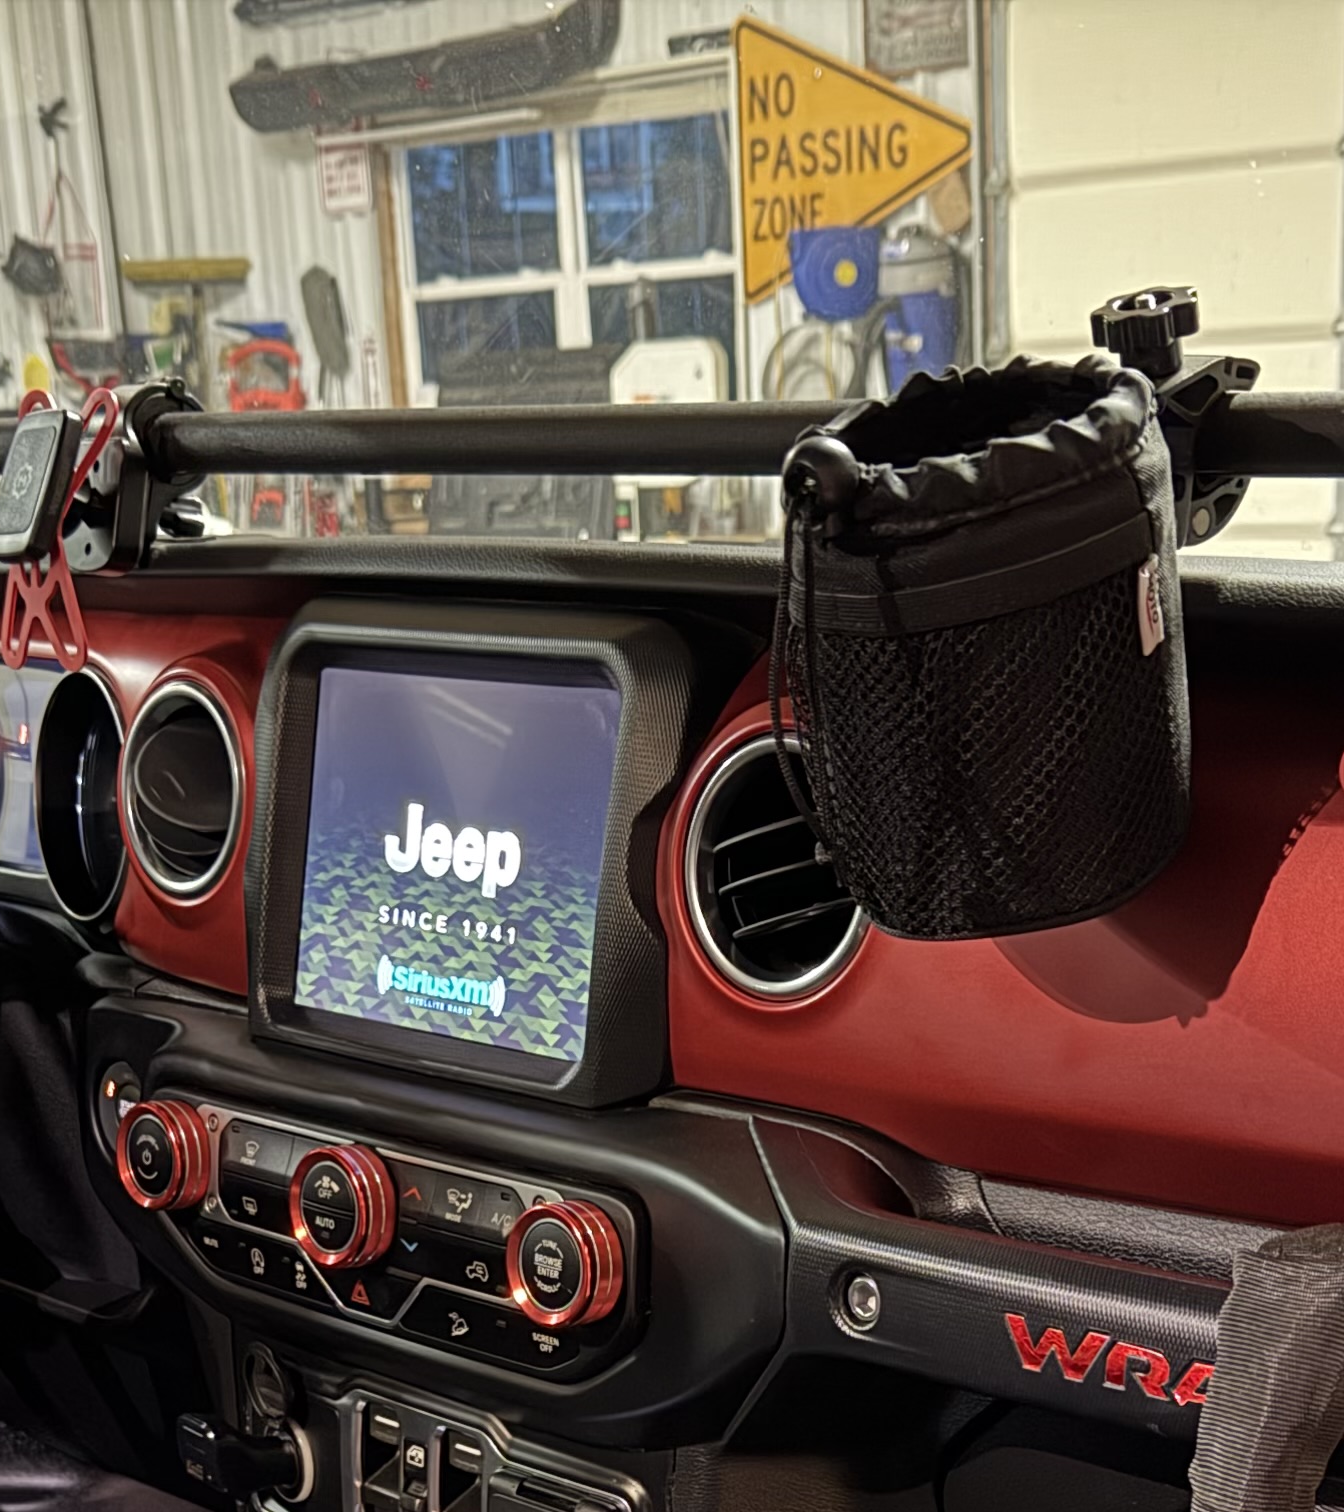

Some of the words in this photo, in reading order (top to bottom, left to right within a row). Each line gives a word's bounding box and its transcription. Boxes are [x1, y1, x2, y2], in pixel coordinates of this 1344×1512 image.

[748, 72, 795, 123] NO
[749, 122, 909, 184] PASSING
[384, 802, 522, 899] Jeep
[378, 905, 449, 935] SINCE
[461, 919, 518, 945] 1941
[447, 1003, 473, 1017] RADIO
[318, 1188, 333, 1200] OFF
[315, 1215, 336, 1230] AUTO
[491, 1212, 513, 1227] A/C
[534, 1252, 563, 1269] BROWSE
[537, 1265, 560, 1280] ENTER
[532, 1332, 560, 1347] SCREEN
[539, 1343, 554, 1354] OFF
